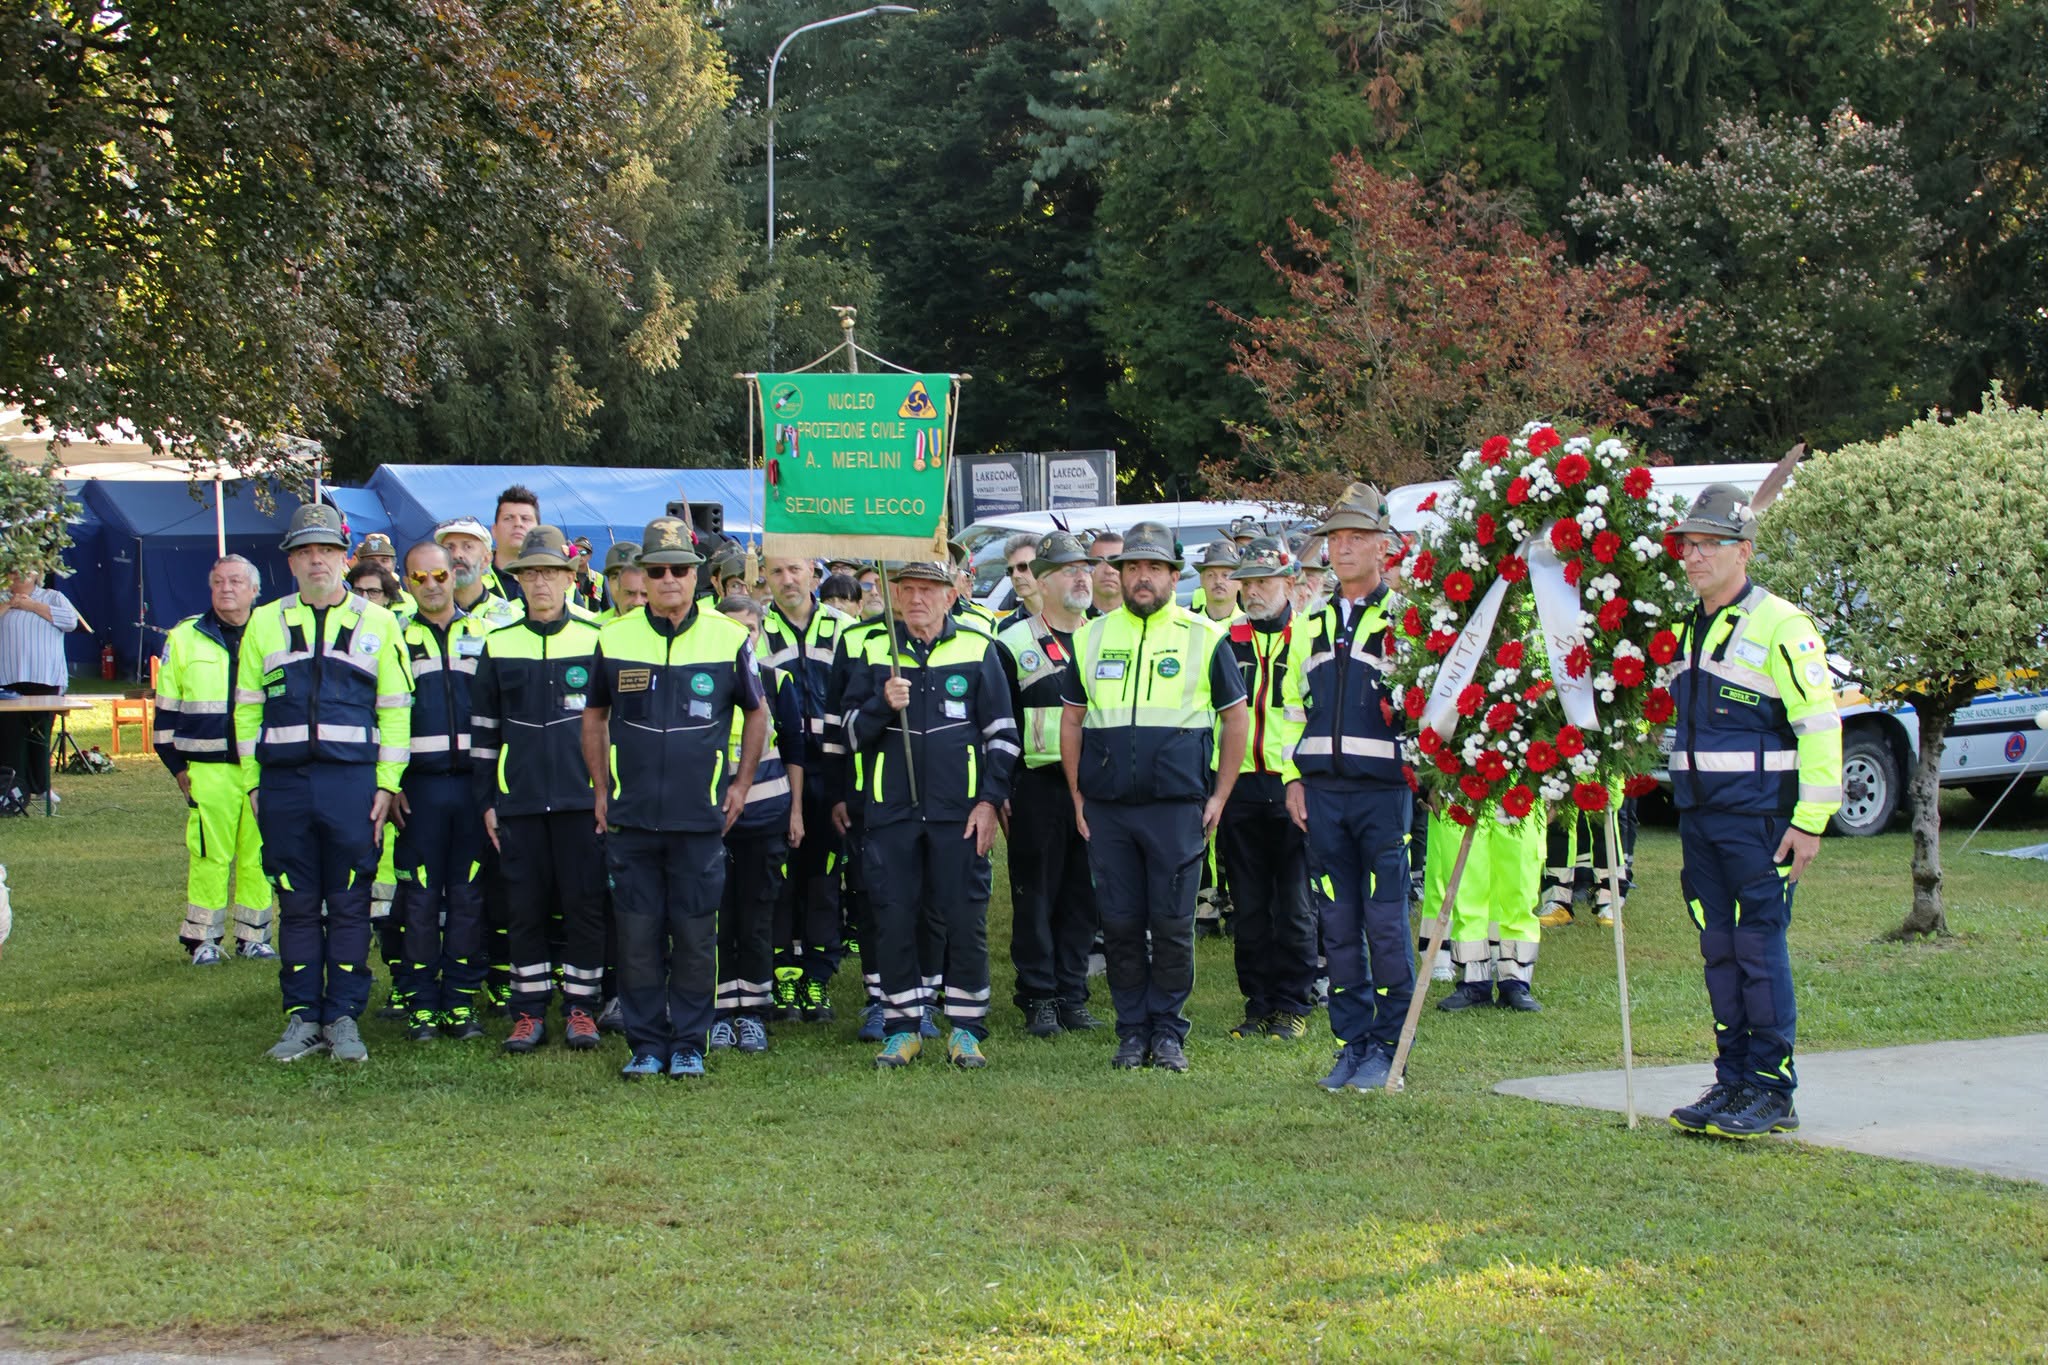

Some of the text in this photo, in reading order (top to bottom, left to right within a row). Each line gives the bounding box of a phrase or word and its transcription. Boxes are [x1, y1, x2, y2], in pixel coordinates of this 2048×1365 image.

[828, 393, 875, 410] NUCLEO
[797, 422, 906, 439] PROTEZIONE CIVILE
[805, 451, 901, 470] A. MERLINI
[785, 497, 926, 516] SEZIONE LECCO
[1439, 612, 1483, 700] UNITAS
[1976, 707, 2007, 718] NAZIONALE
[2009, 705, 2027, 715] ALPINI
